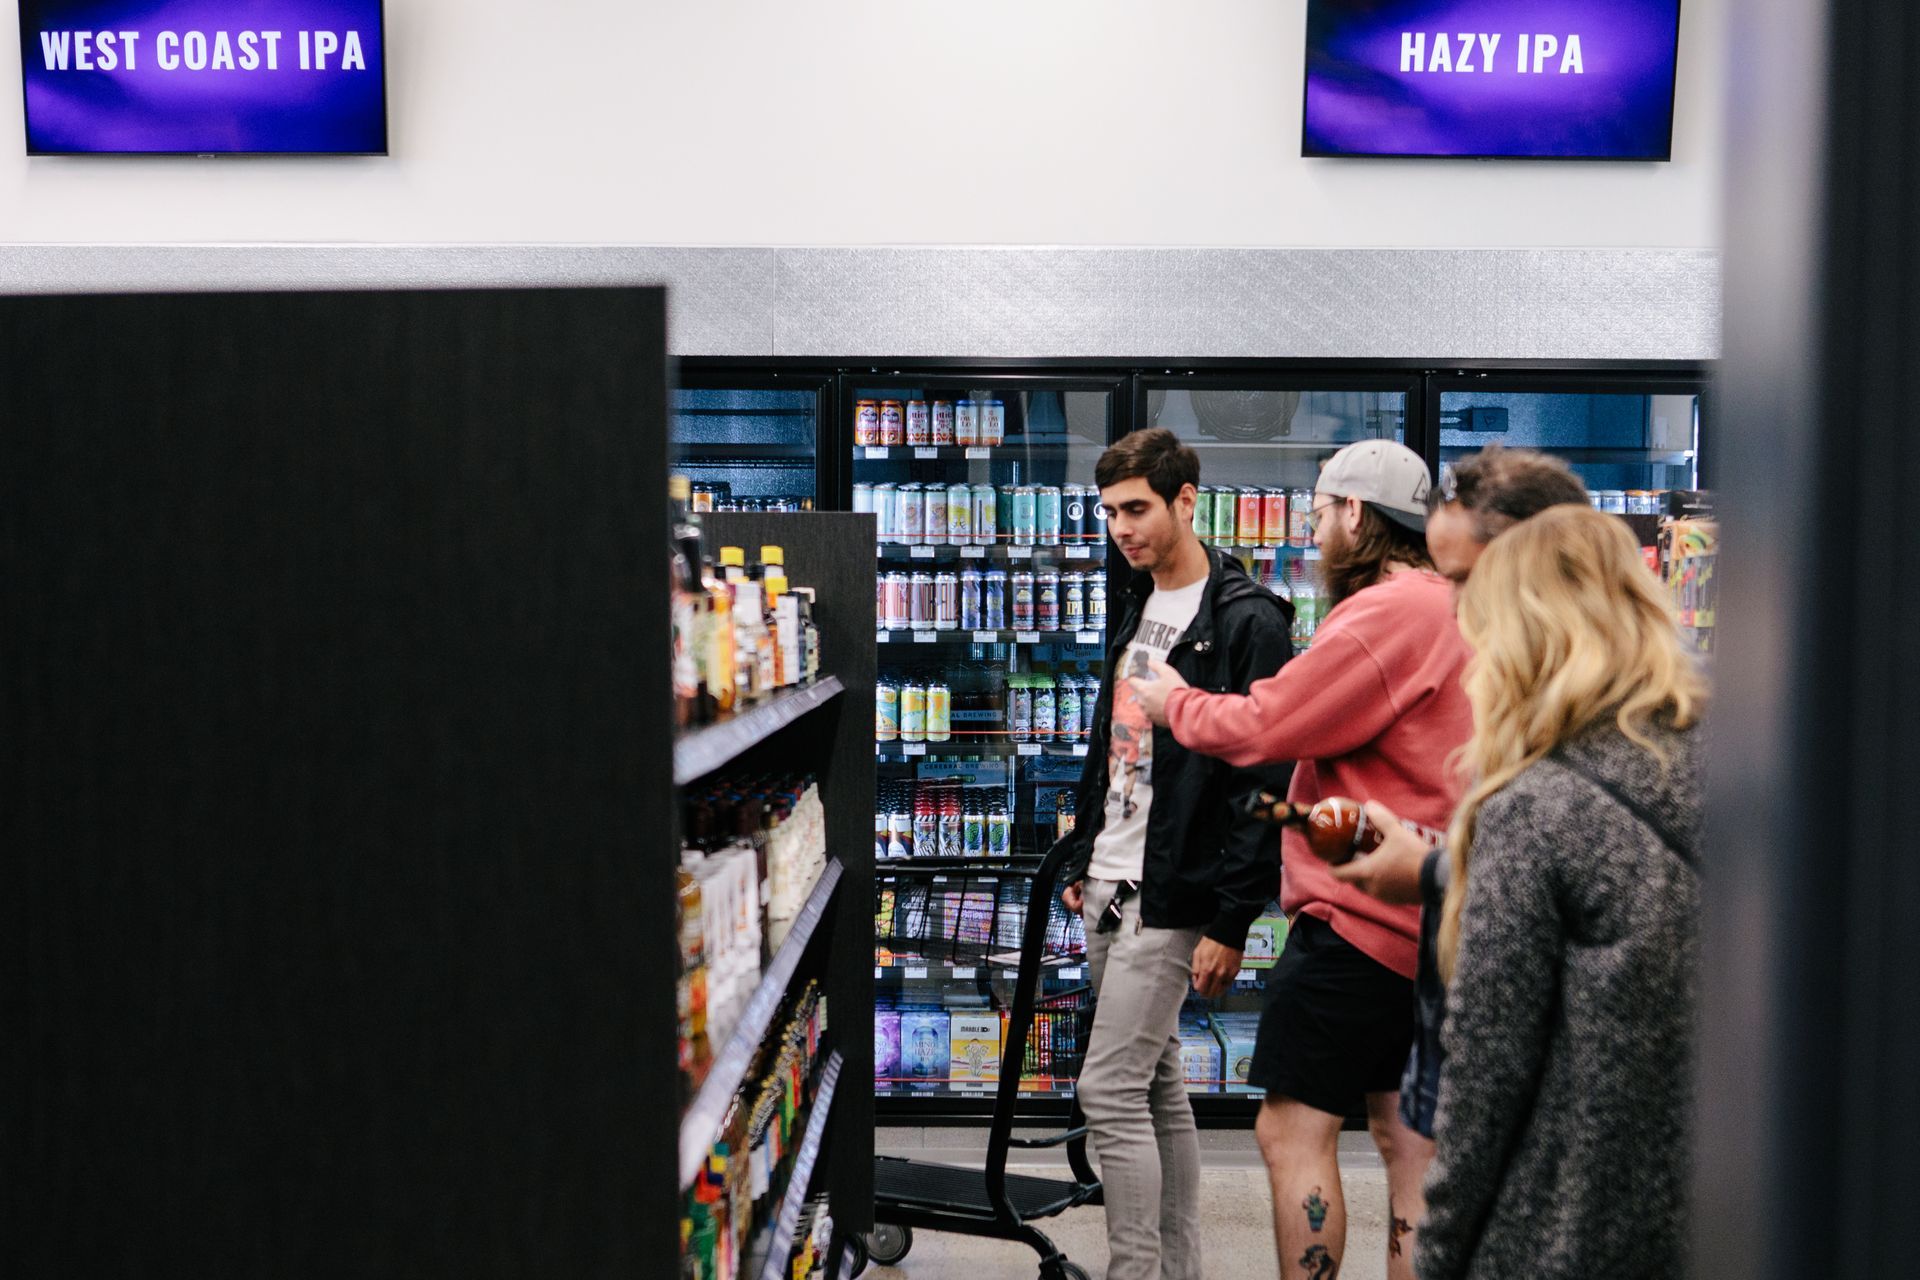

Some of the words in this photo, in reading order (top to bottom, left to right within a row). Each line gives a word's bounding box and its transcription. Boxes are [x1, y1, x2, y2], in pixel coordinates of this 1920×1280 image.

[40, 31, 140, 70] WEST
[156, 31, 282, 70] COAST
[299, 31, 366, 70] IPA
[1400, 32, 1501, 72] HAZY
[1517, 34, 1584, 74] IPA
